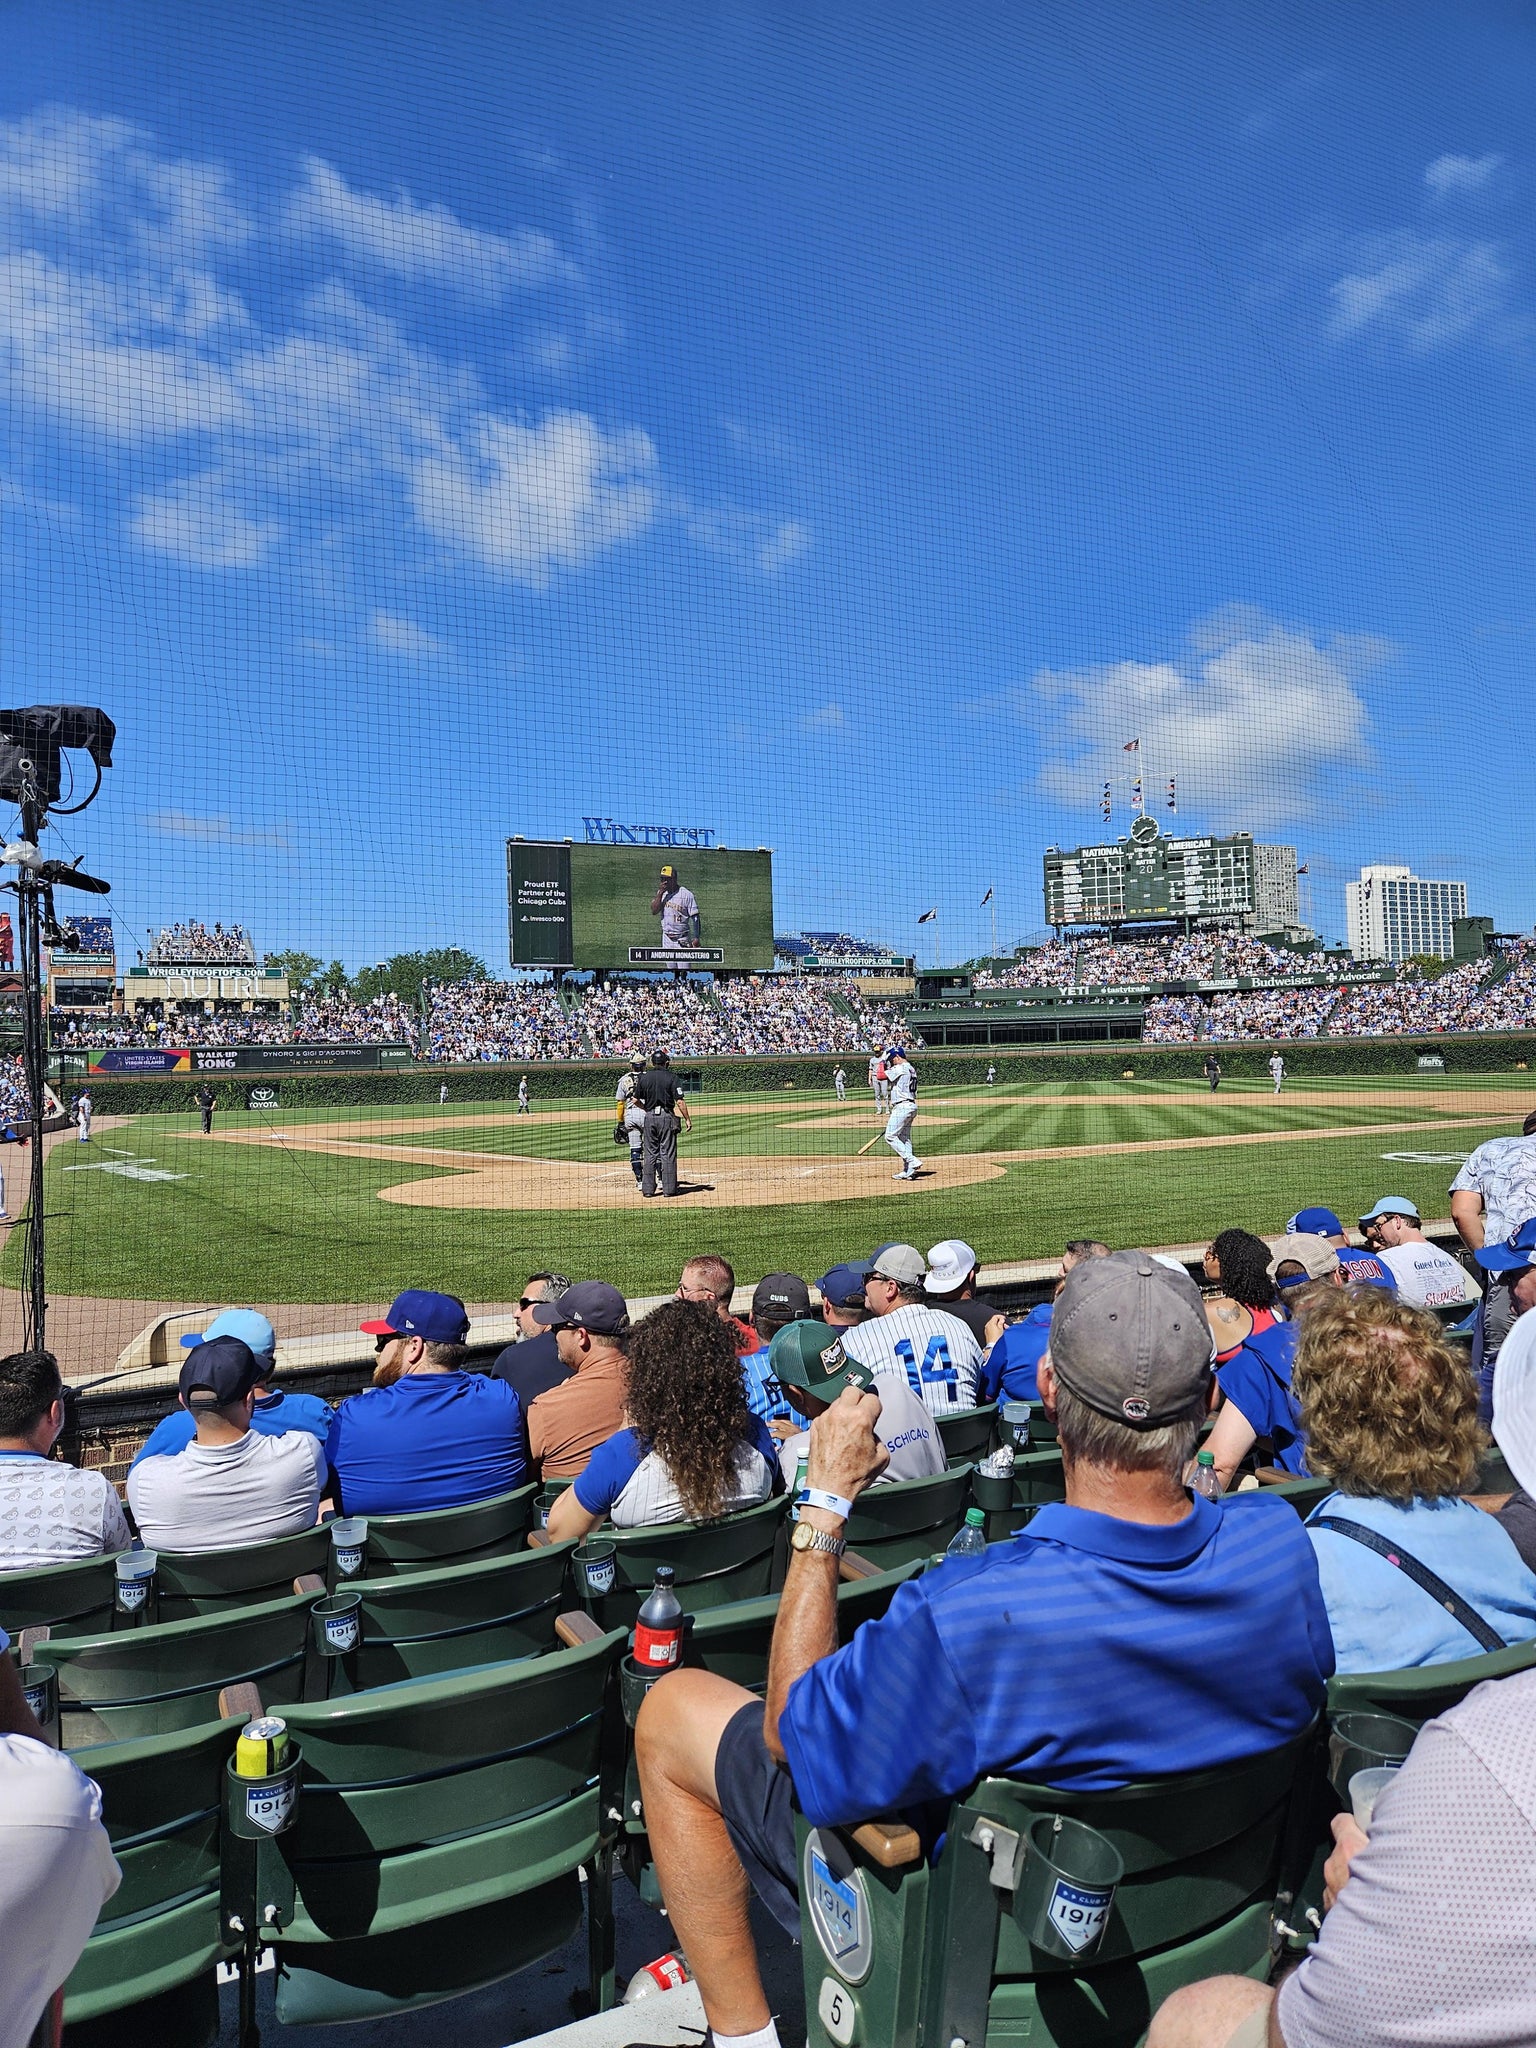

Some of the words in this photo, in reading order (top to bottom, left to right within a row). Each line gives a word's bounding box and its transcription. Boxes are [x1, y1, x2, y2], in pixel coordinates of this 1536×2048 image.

[1167, 839, 1212, 851] AMERICAN
[1082, 846, 1125, 858] NATIONAL
[1140, 865, 1153, 874] 20
[517, 897, 547, 906] Chicago
[651, 951, 675, 959] ANDRUW
[675, 951, 710, 960] MONASTERIO
[818, 957, 892, 965] WRIGLEYROOFTOPS.COM
[147, 967, 266, 977] WRIGLEYROOFTOPS.COM
[1338, 972, 1381, 982] Advocate
[1198, 979, 1238, 987] GRAINGER
[1058, 986, 1090, 996] YETI
[1107, 985, 1151, 994] tastytrade
[196, 1051, 238, 1059] WALK-UP
[63, 1054, 85, 1068] BEAM
[197, 1059, 236, 1069] SONG
[1420, 1058, 1444, 1066] Hefty
[1414, 1260, 1433, 1270] Guest
[1434, 1258, 1452, 1268] Check
[770, 1294, 789, 1302] CUBS
[894, 1335, 959, 1402] 14
[340, 1555, 359, 1563] 1914
[592, 1566, 613, 1581] 1914
[122, 1589, 144, 1598] 1914
[331, 1623, 357, 1638] 1914
[265, 1787, 284, 1796] CLUB
[254, 1793, 292, 1814] 1914
[1078, 1896, 1101, 1905] CLUB
[817, 1882, 853, 1931] 1914
[1059, 1905, 1106, 1925] 1914
[831, 1993, 843, 2026] 5
